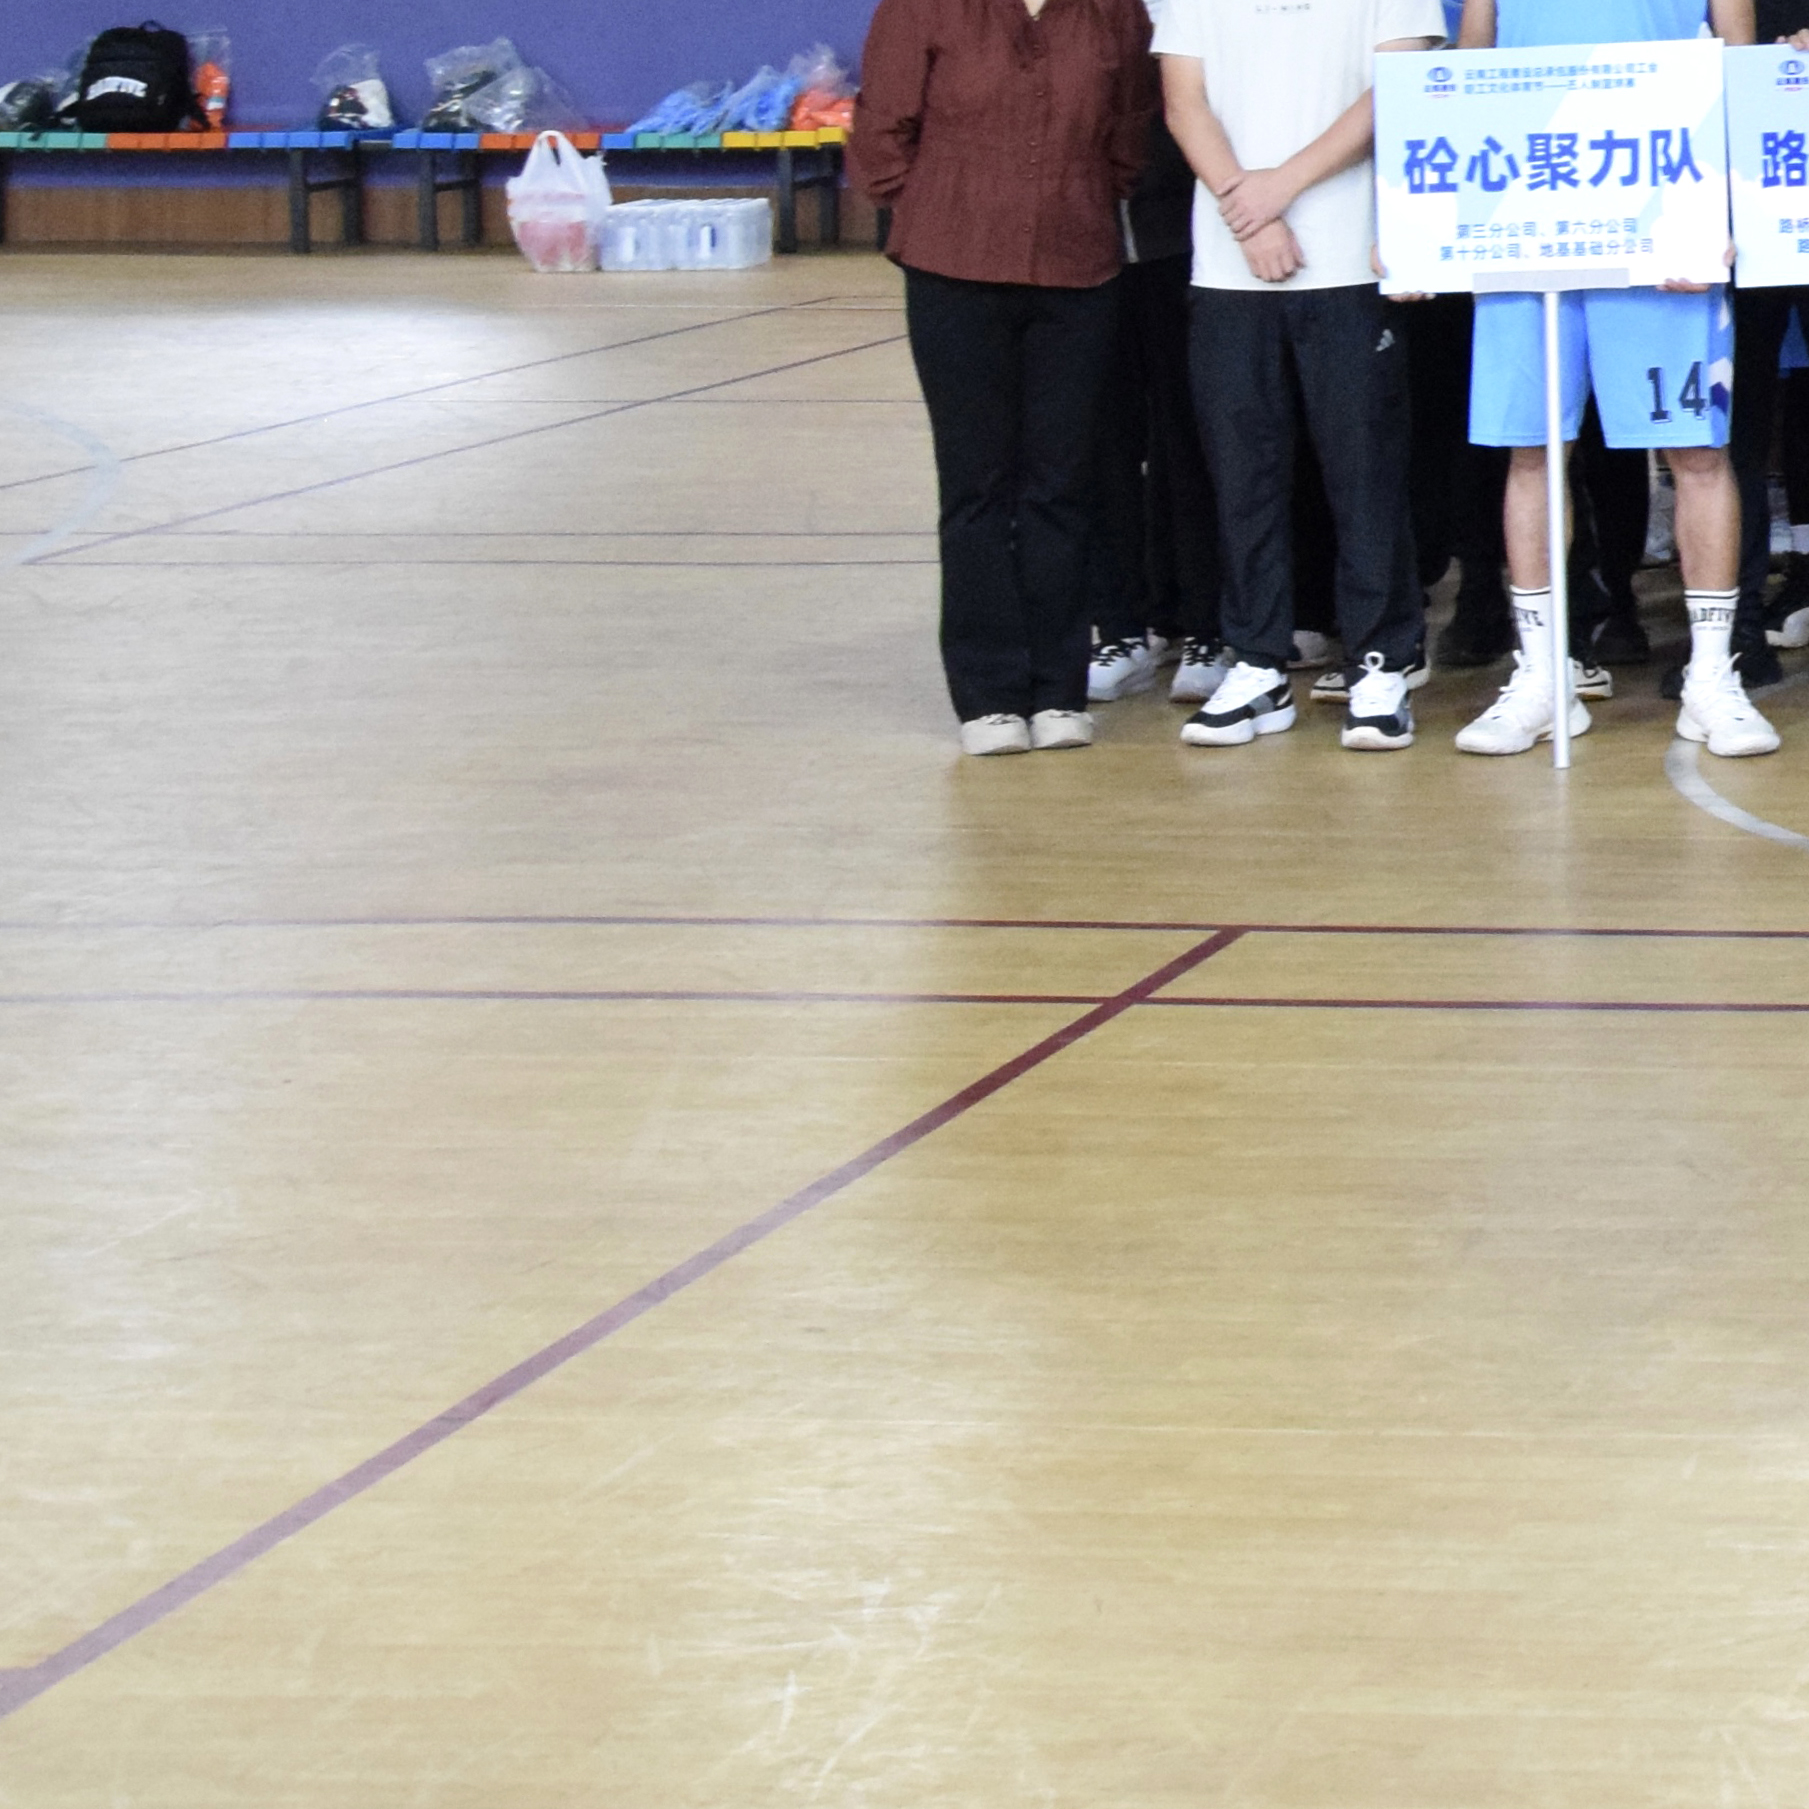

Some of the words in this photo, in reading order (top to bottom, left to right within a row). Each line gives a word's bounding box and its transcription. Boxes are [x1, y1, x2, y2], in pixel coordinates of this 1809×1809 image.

[1403, 127, 1703, 195] 砼心聚力队
[1646, 361, 1709, 424] 14
